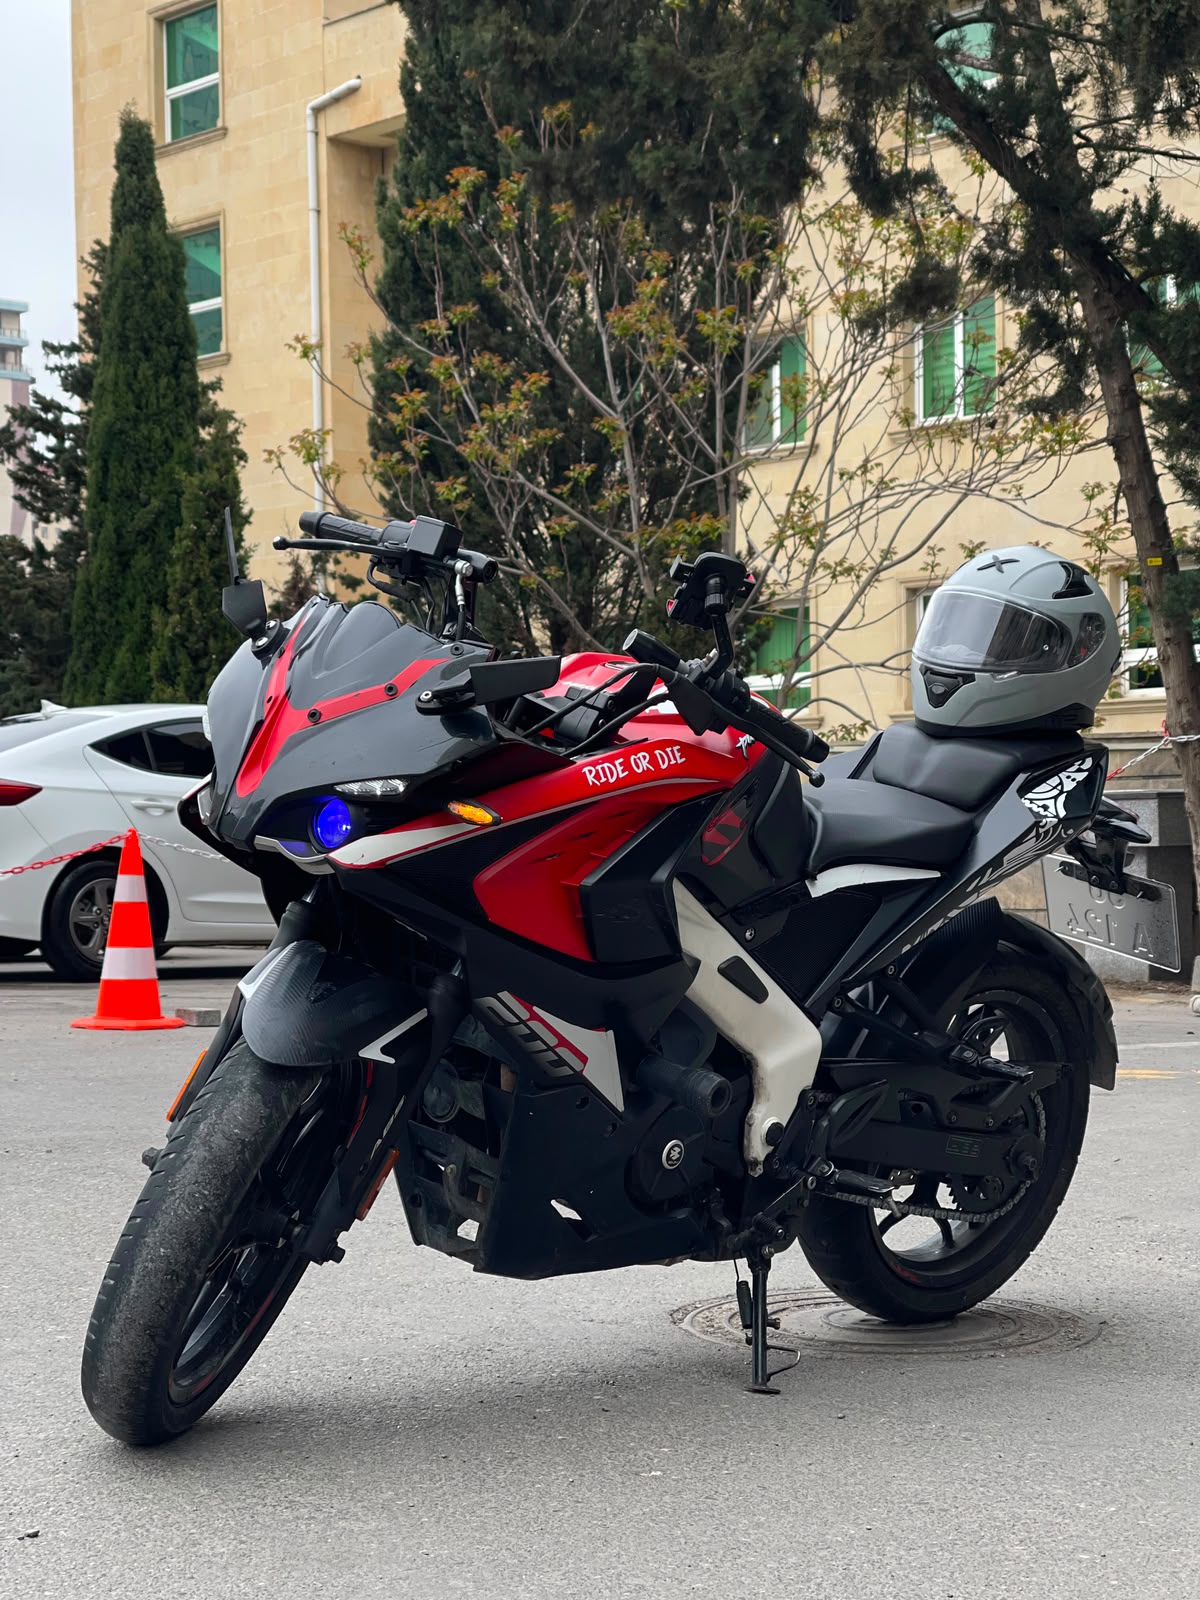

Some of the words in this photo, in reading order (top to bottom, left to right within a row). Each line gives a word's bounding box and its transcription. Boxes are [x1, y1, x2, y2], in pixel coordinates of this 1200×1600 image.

[582, 759, 628, 786] RIDE
[630, 751, 654, 773] OR
[655, 745, 685, 769] DIE
